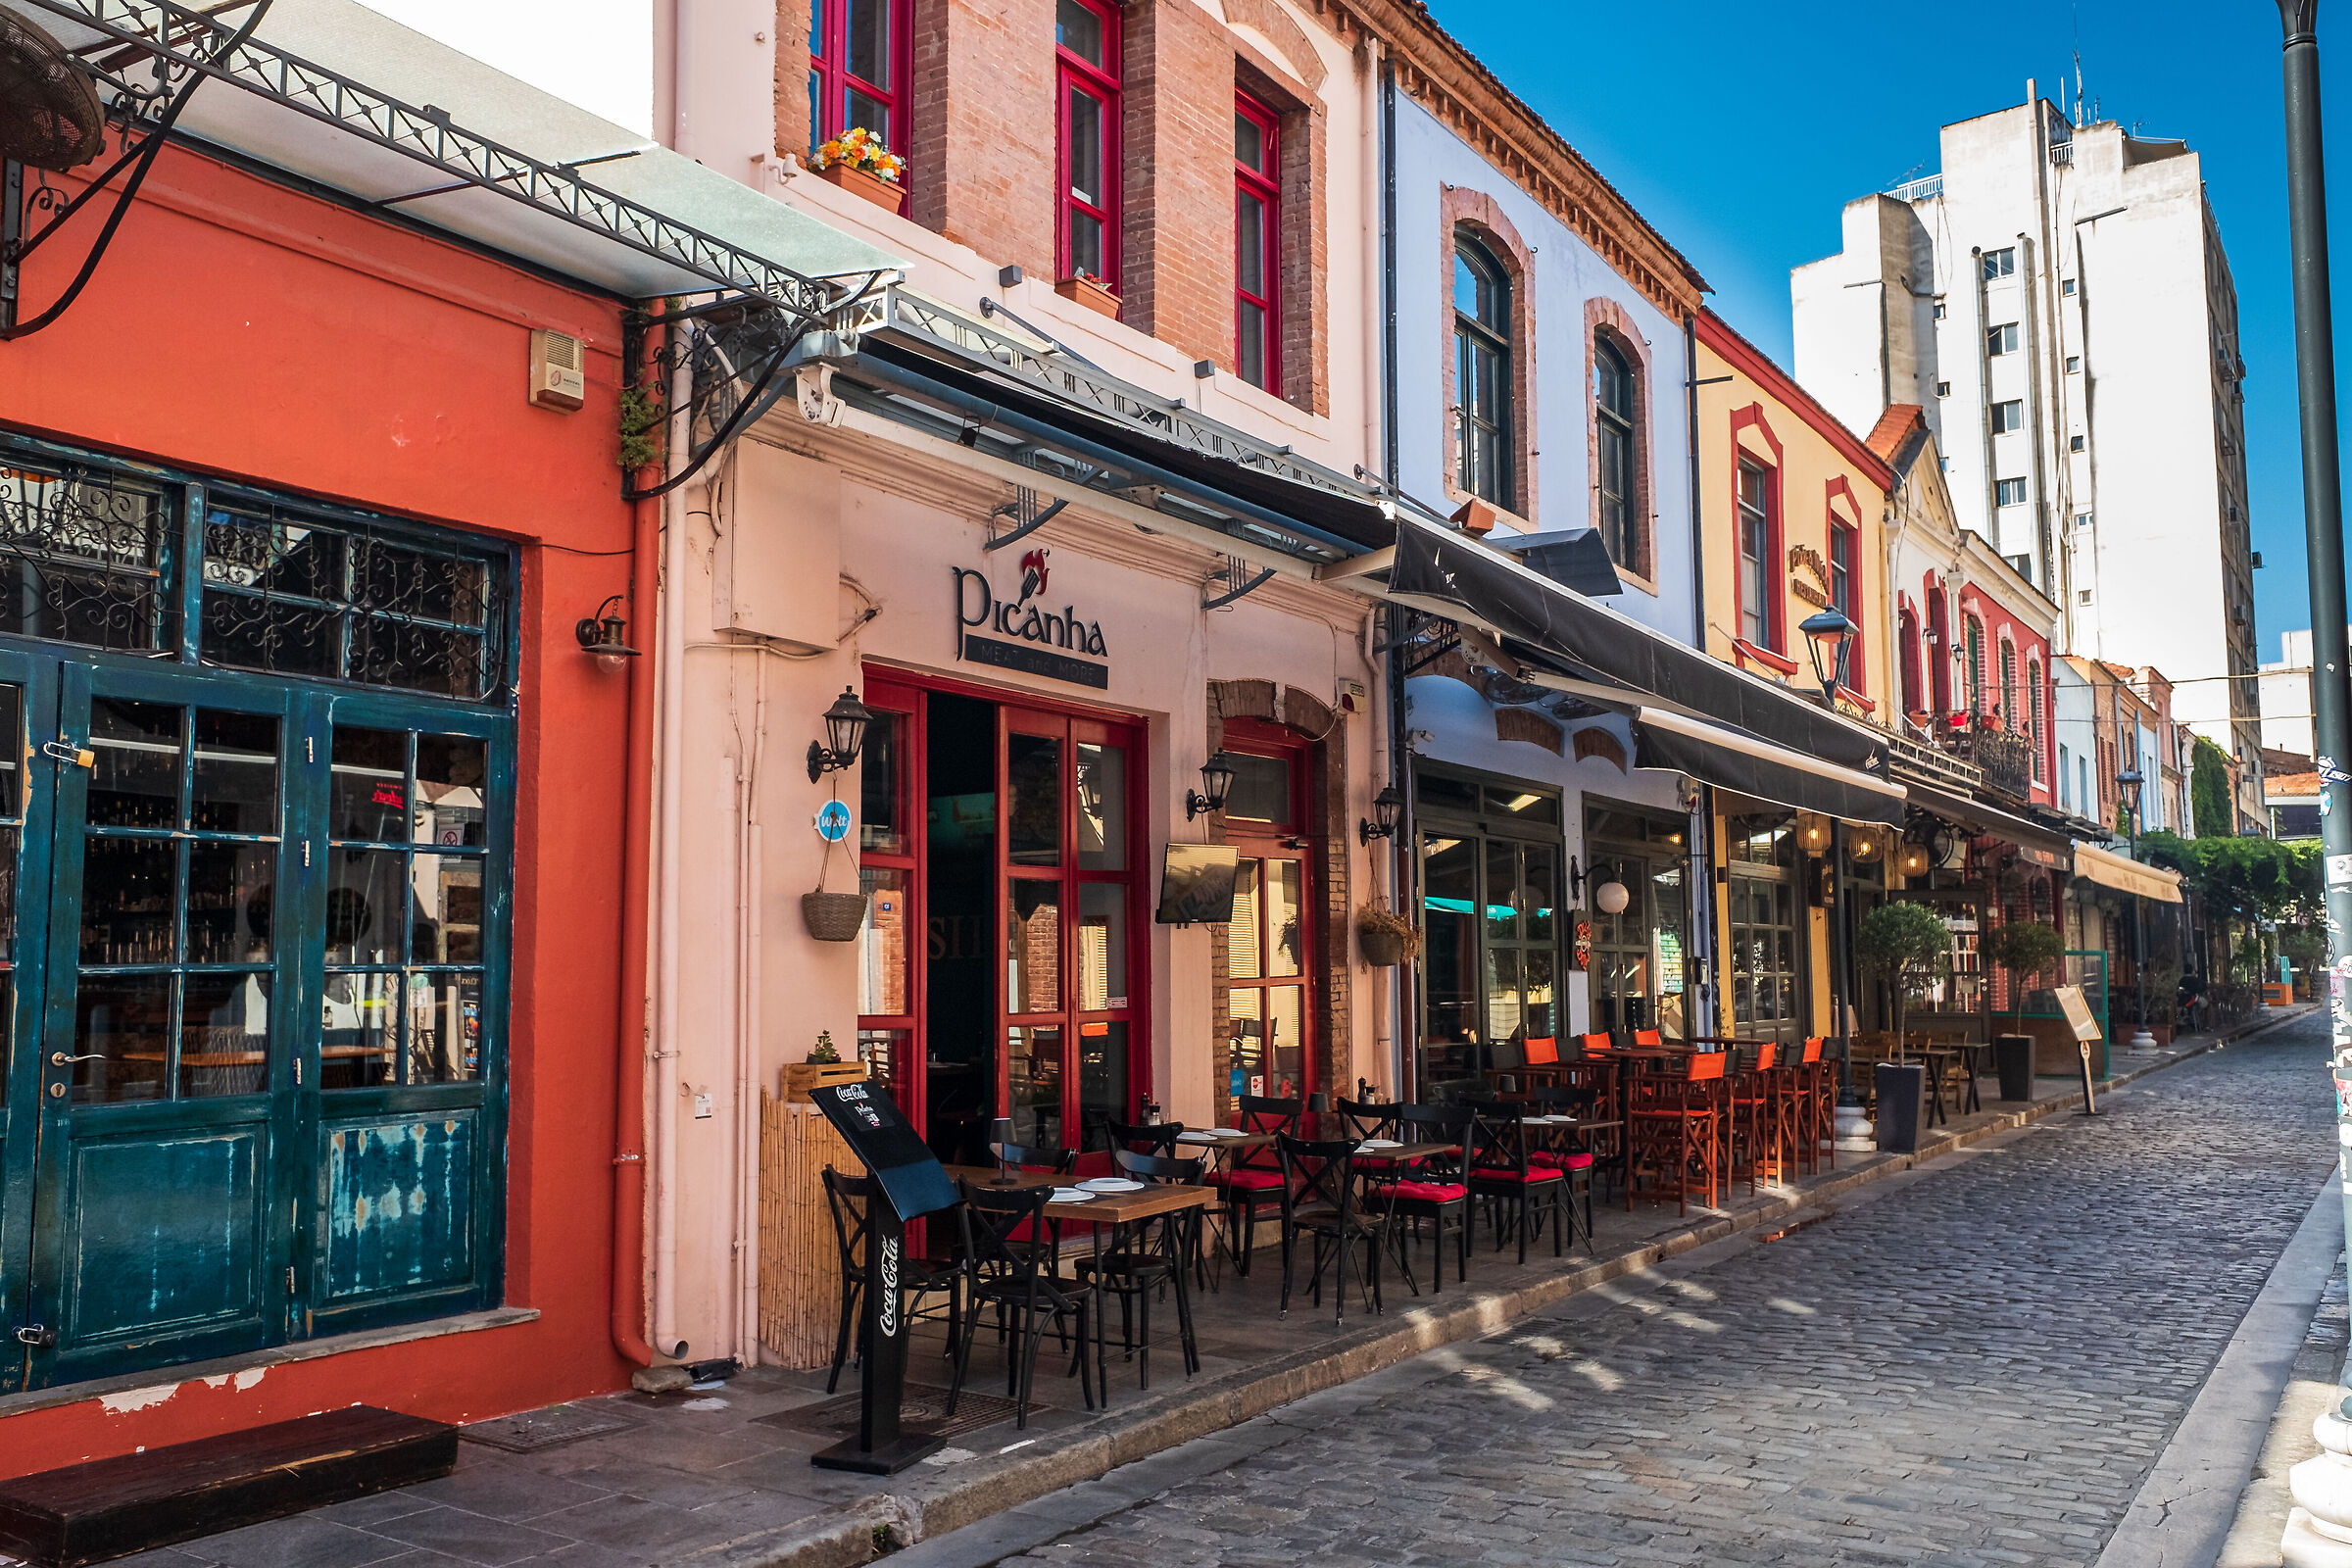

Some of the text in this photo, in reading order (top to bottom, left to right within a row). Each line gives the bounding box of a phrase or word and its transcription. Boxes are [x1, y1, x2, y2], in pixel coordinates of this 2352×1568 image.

[952, 566, 1108, 662] Picanha
[981, 644, 1096, 683] MEAT and MORE
